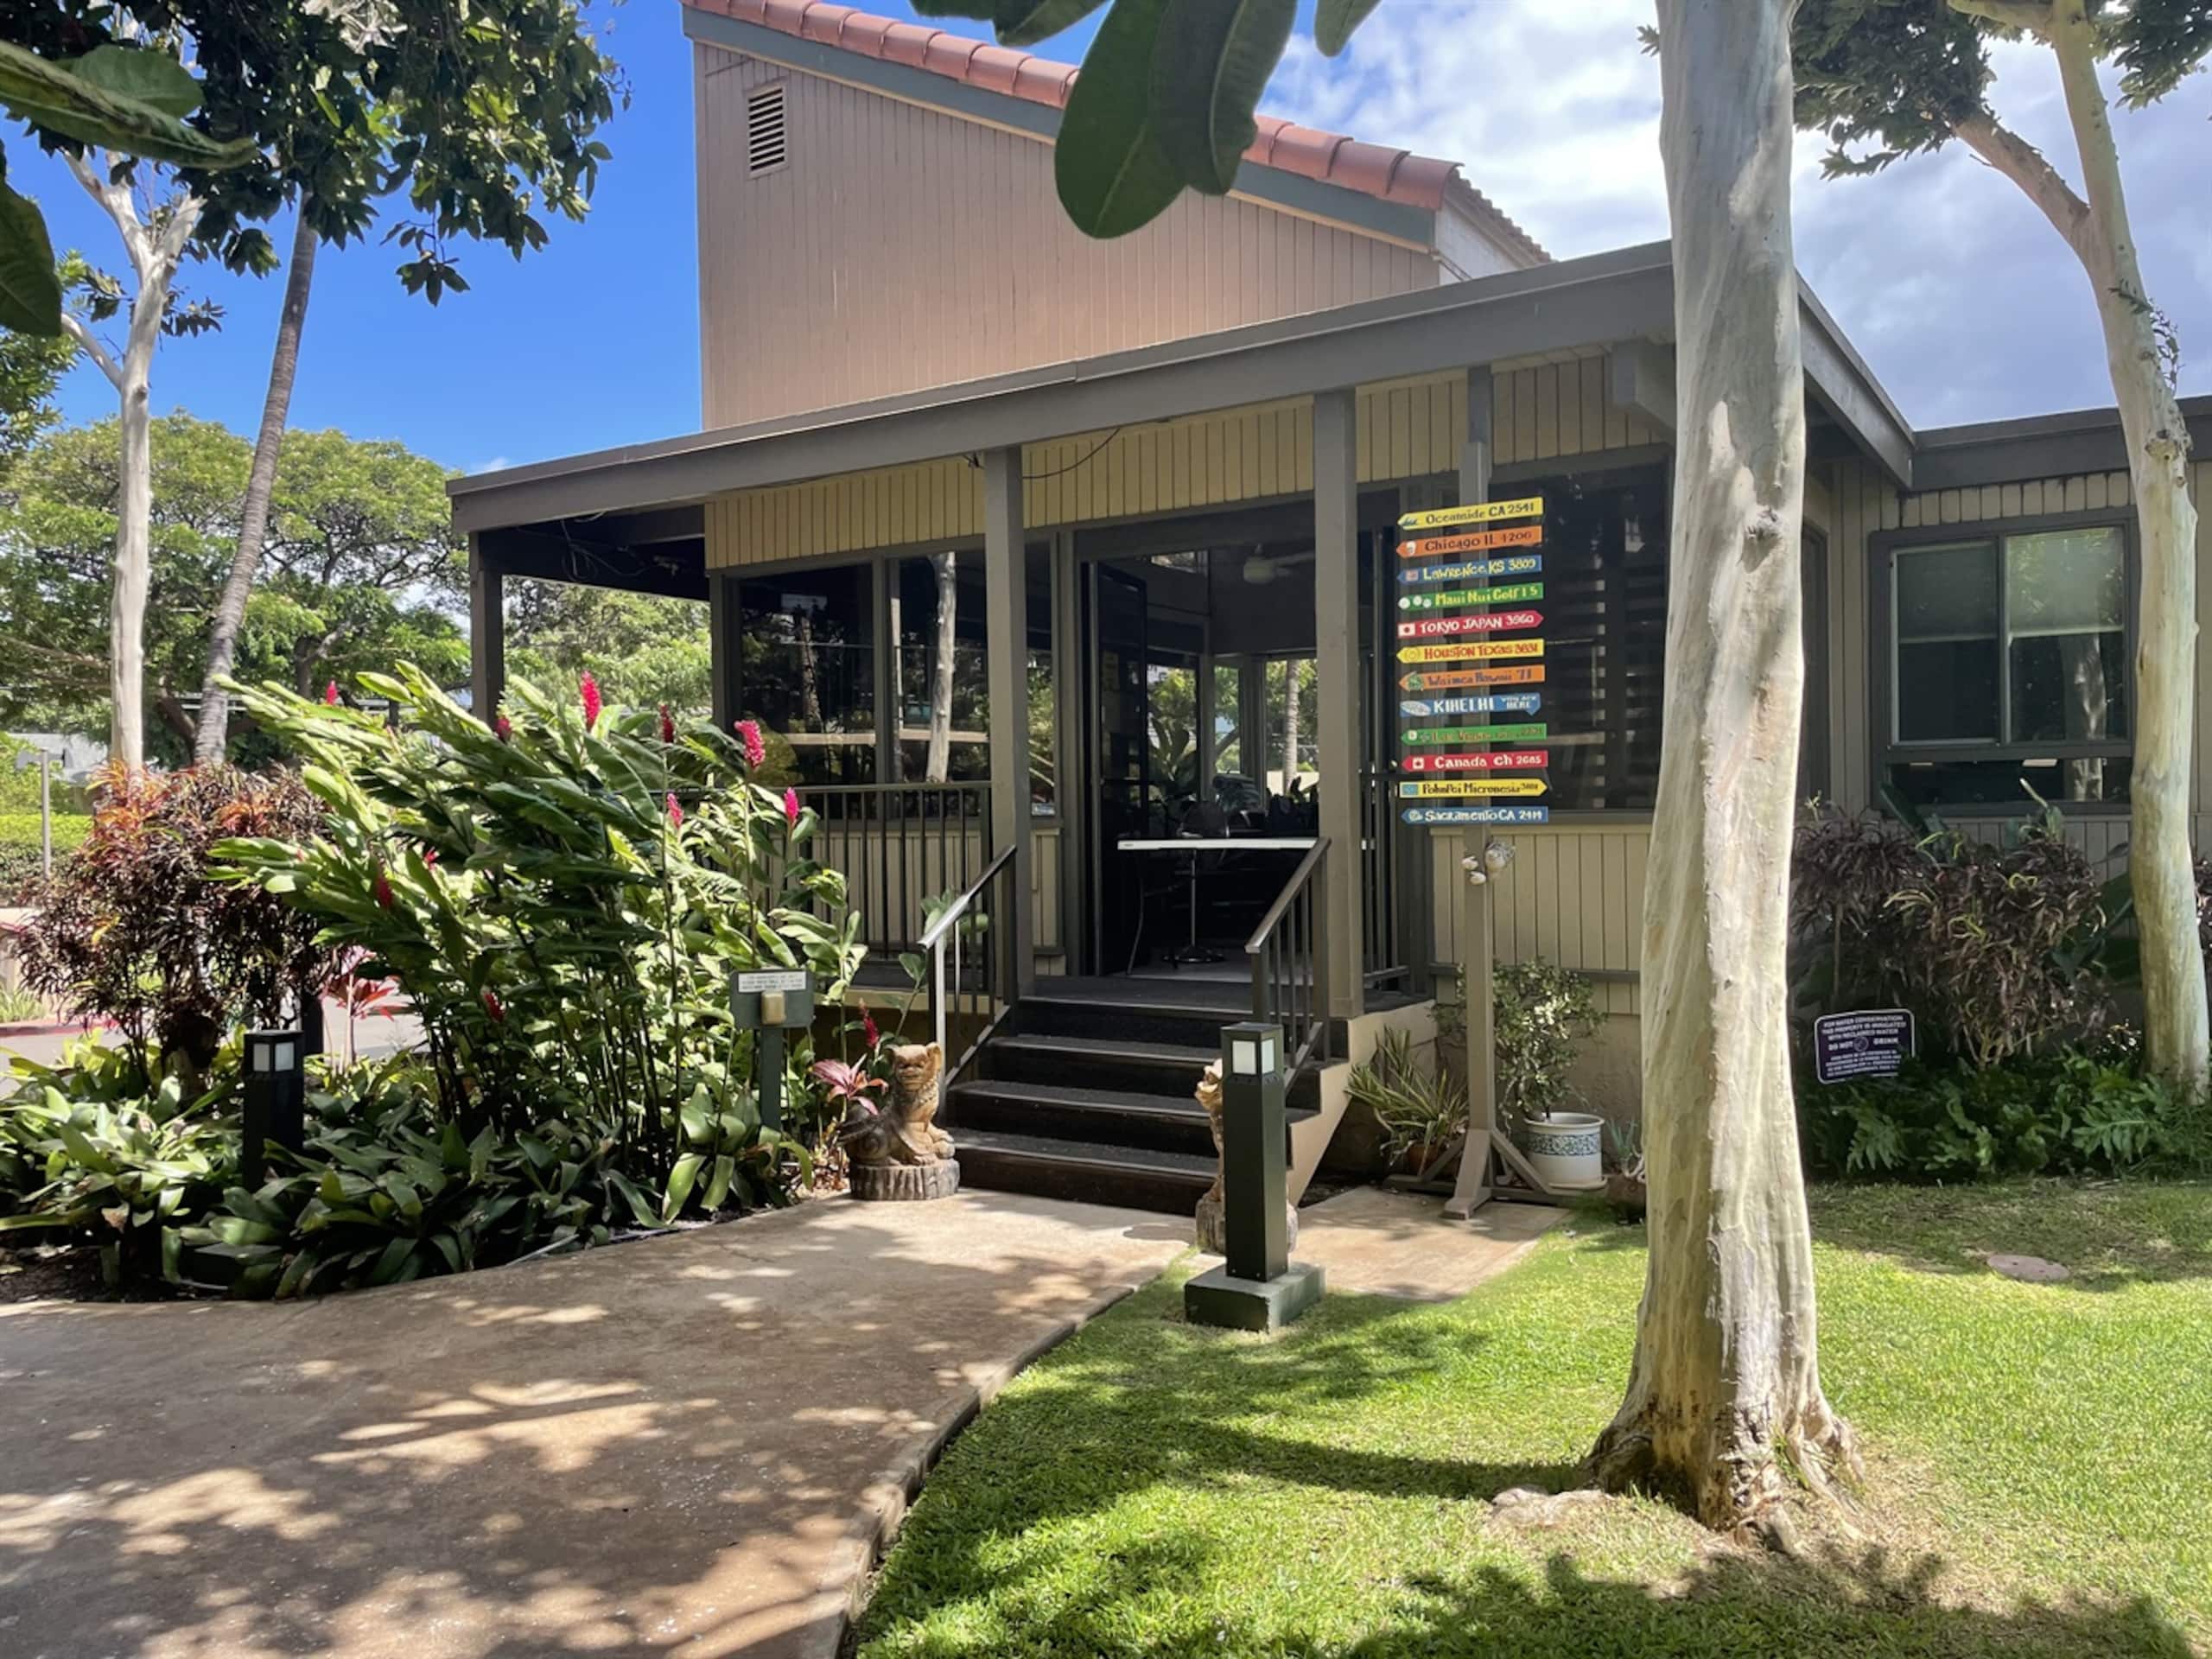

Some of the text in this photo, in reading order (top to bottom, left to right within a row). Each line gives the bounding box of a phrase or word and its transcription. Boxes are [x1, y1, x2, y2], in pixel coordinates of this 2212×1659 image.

[1426, 510, 1484, 524] Oceanside
[1489, 506, 1505, 517] CA
[1425, 537, 1480, 552] Chicago
[1488, 560, 1504, 574] KS
[1435, 589, 1465, 606] Maui
[1467, 589, 1491, 603] Nui
[1492, 588, 1520, 601] Golf
[1421, 621, 1459, 634] TOKYO
[1463, 617, 1502, 630] JAPAN
[1424, 646, 1476, 660] HOUSTON
[1434, 756, 1487, 769] Canada
[1464, 782, 1520, 794] Micronesia
[1498, 810, 1516, 821] CA
